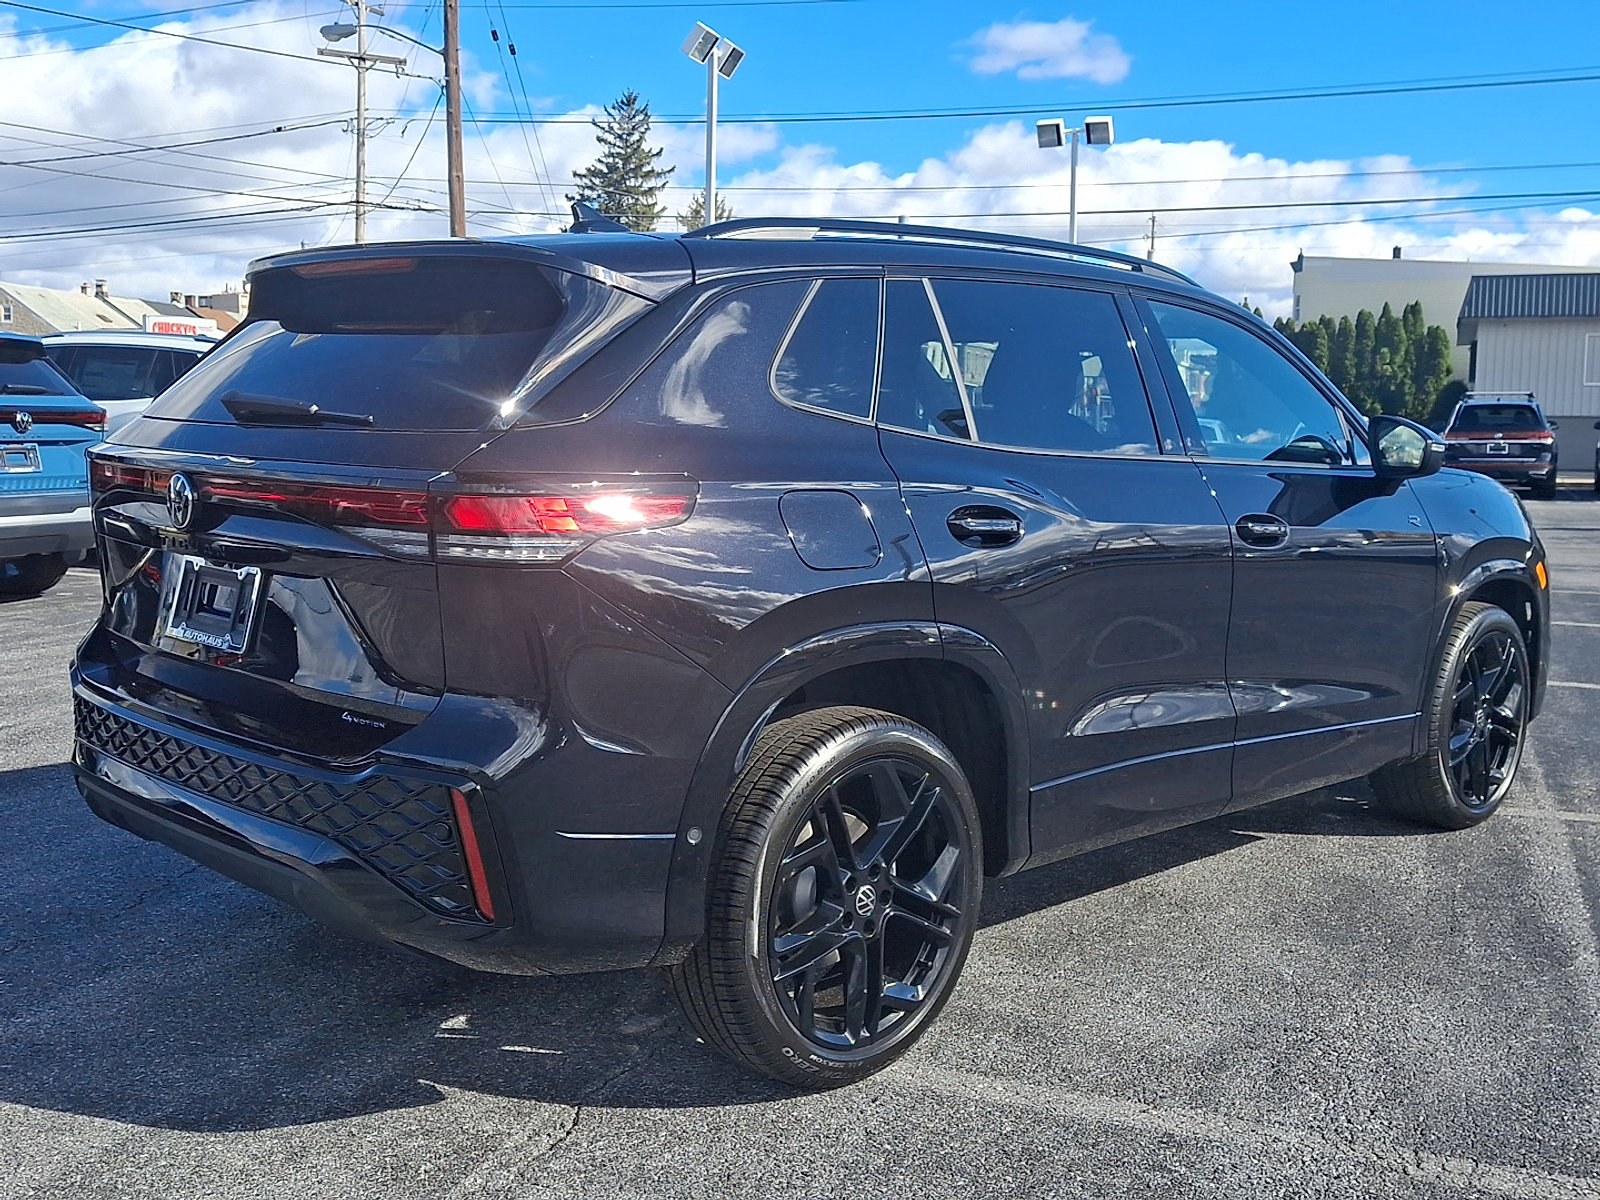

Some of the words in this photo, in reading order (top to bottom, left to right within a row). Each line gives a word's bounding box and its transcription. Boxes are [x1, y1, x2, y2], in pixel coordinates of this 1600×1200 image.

[183, 630, 224, 648] AUTOHAUS
[341, 711, 386, 729] 4MOTION
[780, 1046, 820, 1073] ZERO
